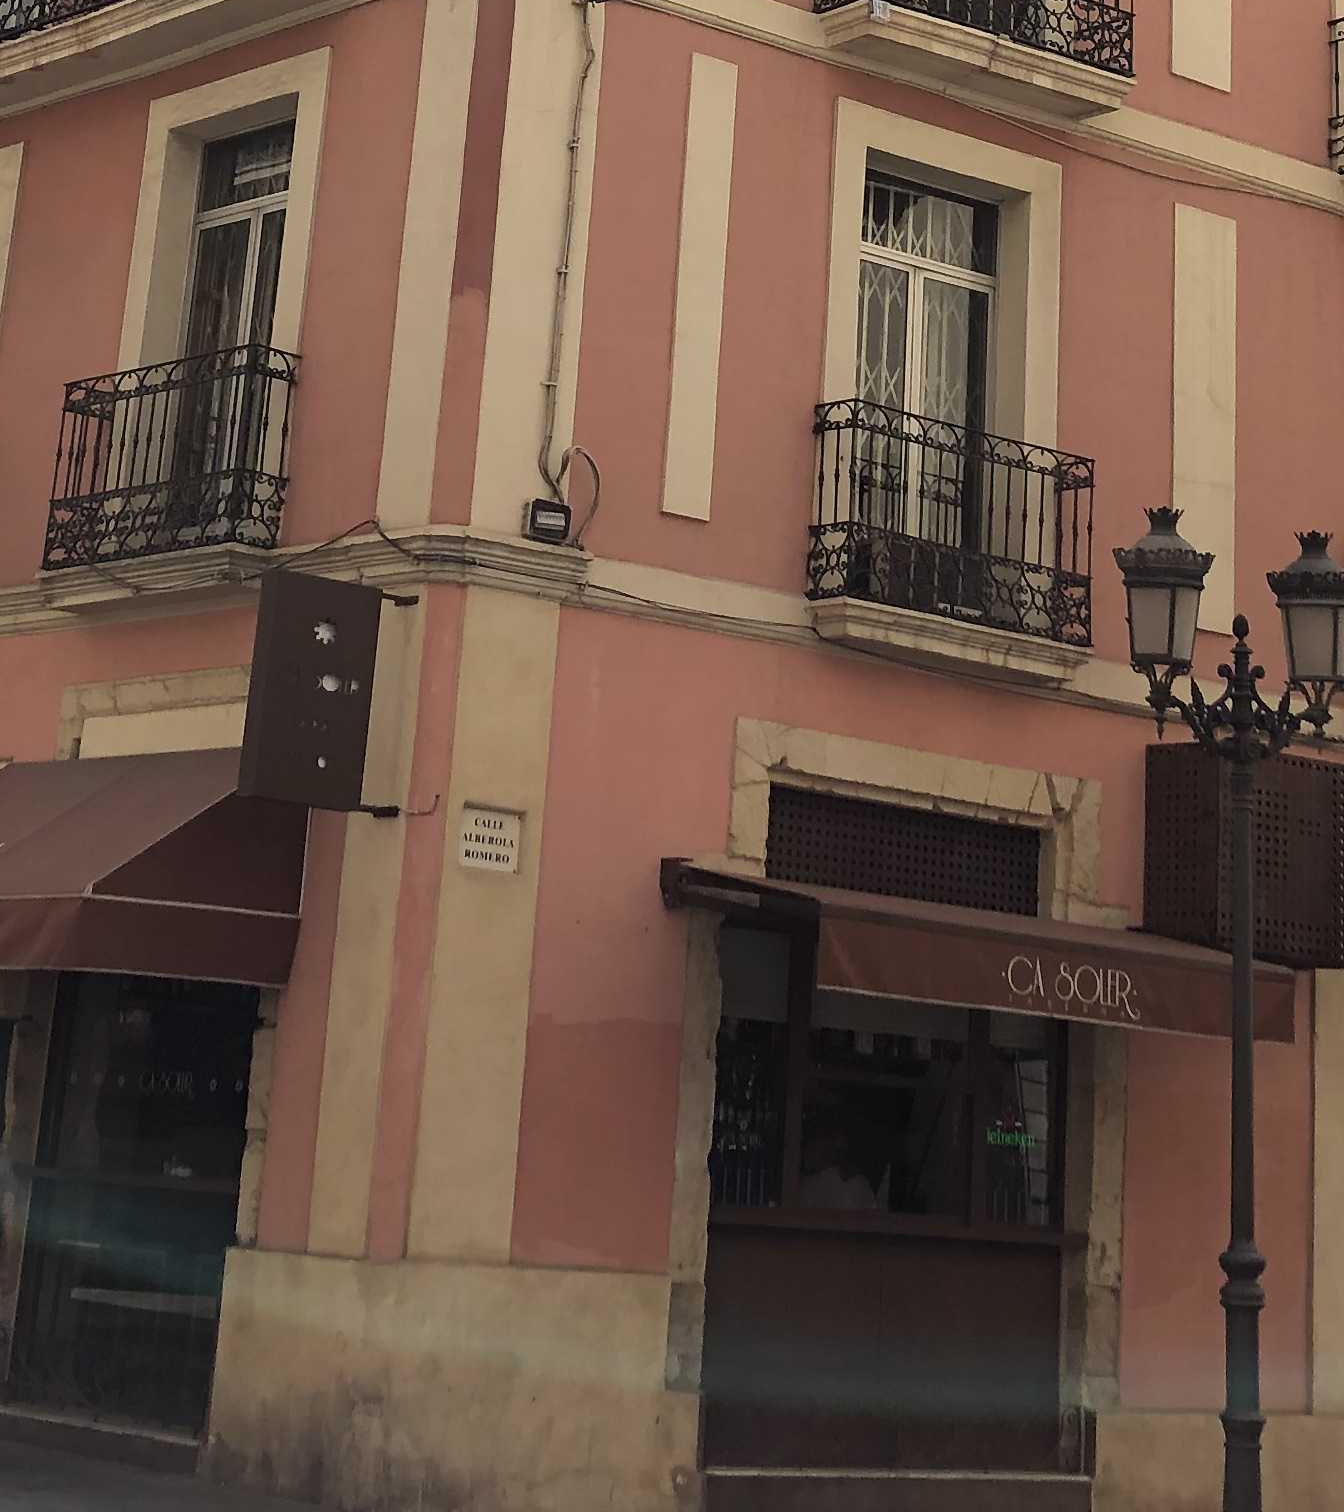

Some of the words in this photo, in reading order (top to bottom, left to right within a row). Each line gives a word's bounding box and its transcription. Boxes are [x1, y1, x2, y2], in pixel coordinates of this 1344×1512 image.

[474, 817, 504, 830] CALLE
[463, 831, 514, 848] ALBEROLA
[464, 849, 510, 864] ROMERO
